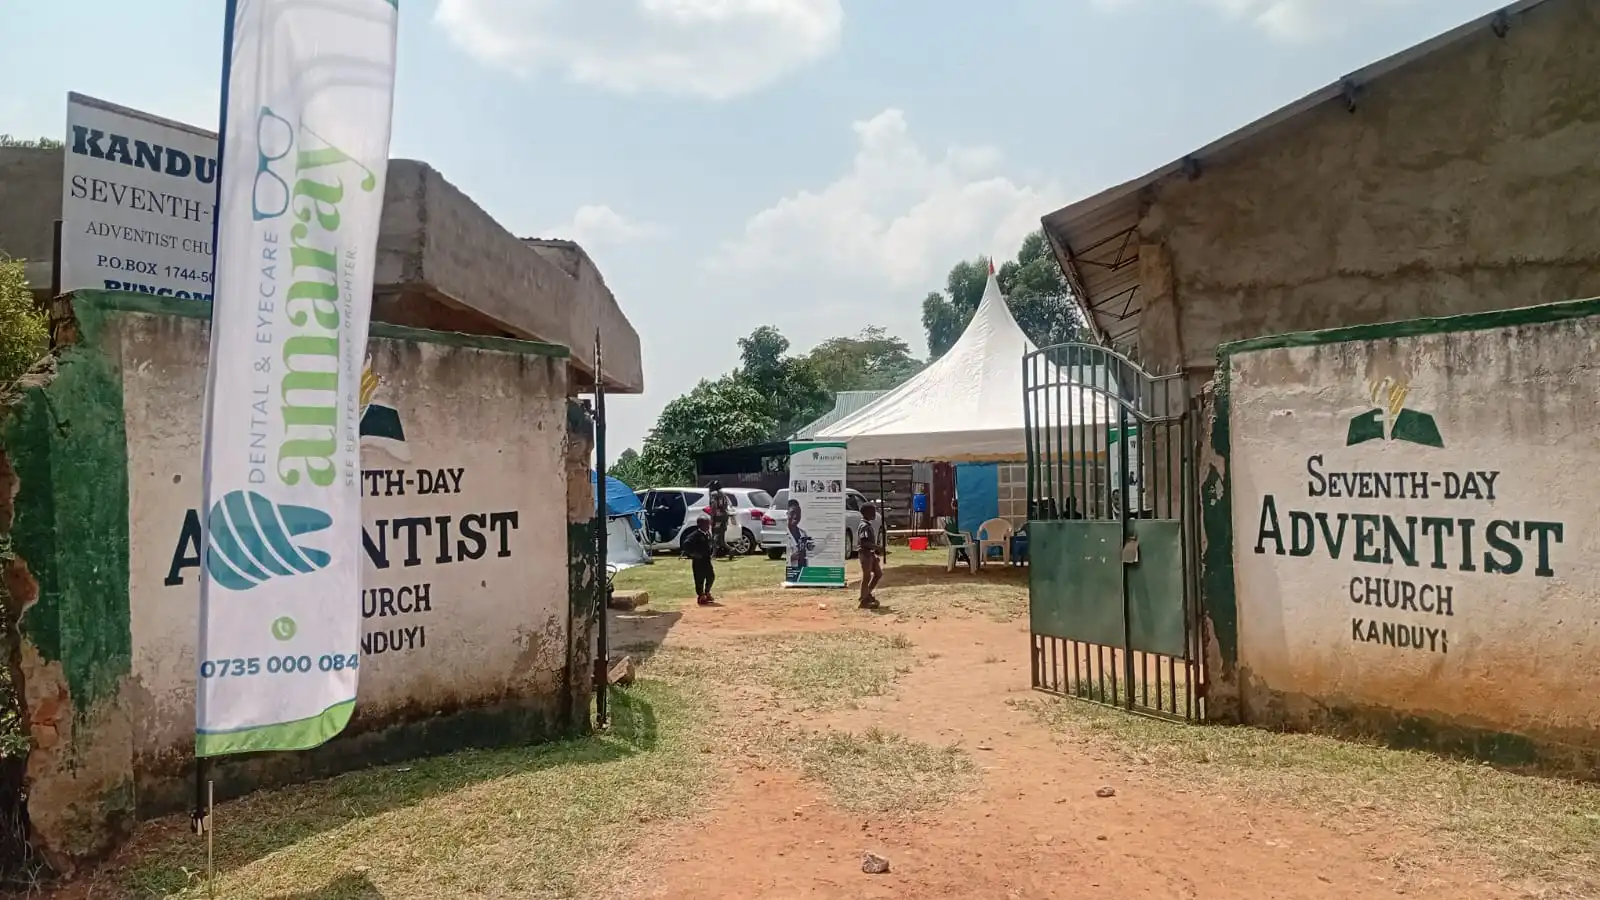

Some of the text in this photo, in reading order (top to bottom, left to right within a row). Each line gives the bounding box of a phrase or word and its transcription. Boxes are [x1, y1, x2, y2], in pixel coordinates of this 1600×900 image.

[71, 175, 215, 225] SEVENTH-
[85, 221, 178, 249] ADVENTIST
[277, 114, 375, 487] amaray
[248, 231, 278, 484] DENTAL & EYECARE
[360, 468, 464, 497] TH-DAY
[1307, 454, 1500, 500] SEVENTH-DAY
[1254, 494, 1564, 577] ADVENTIST
[362, 583, 431, 618] URCH
[1350, 576, 1454, 616] CHURCH
[1352, 618, 1448, 653] KANDUYI
[200, 654, 359, 678] 0735 000 084
